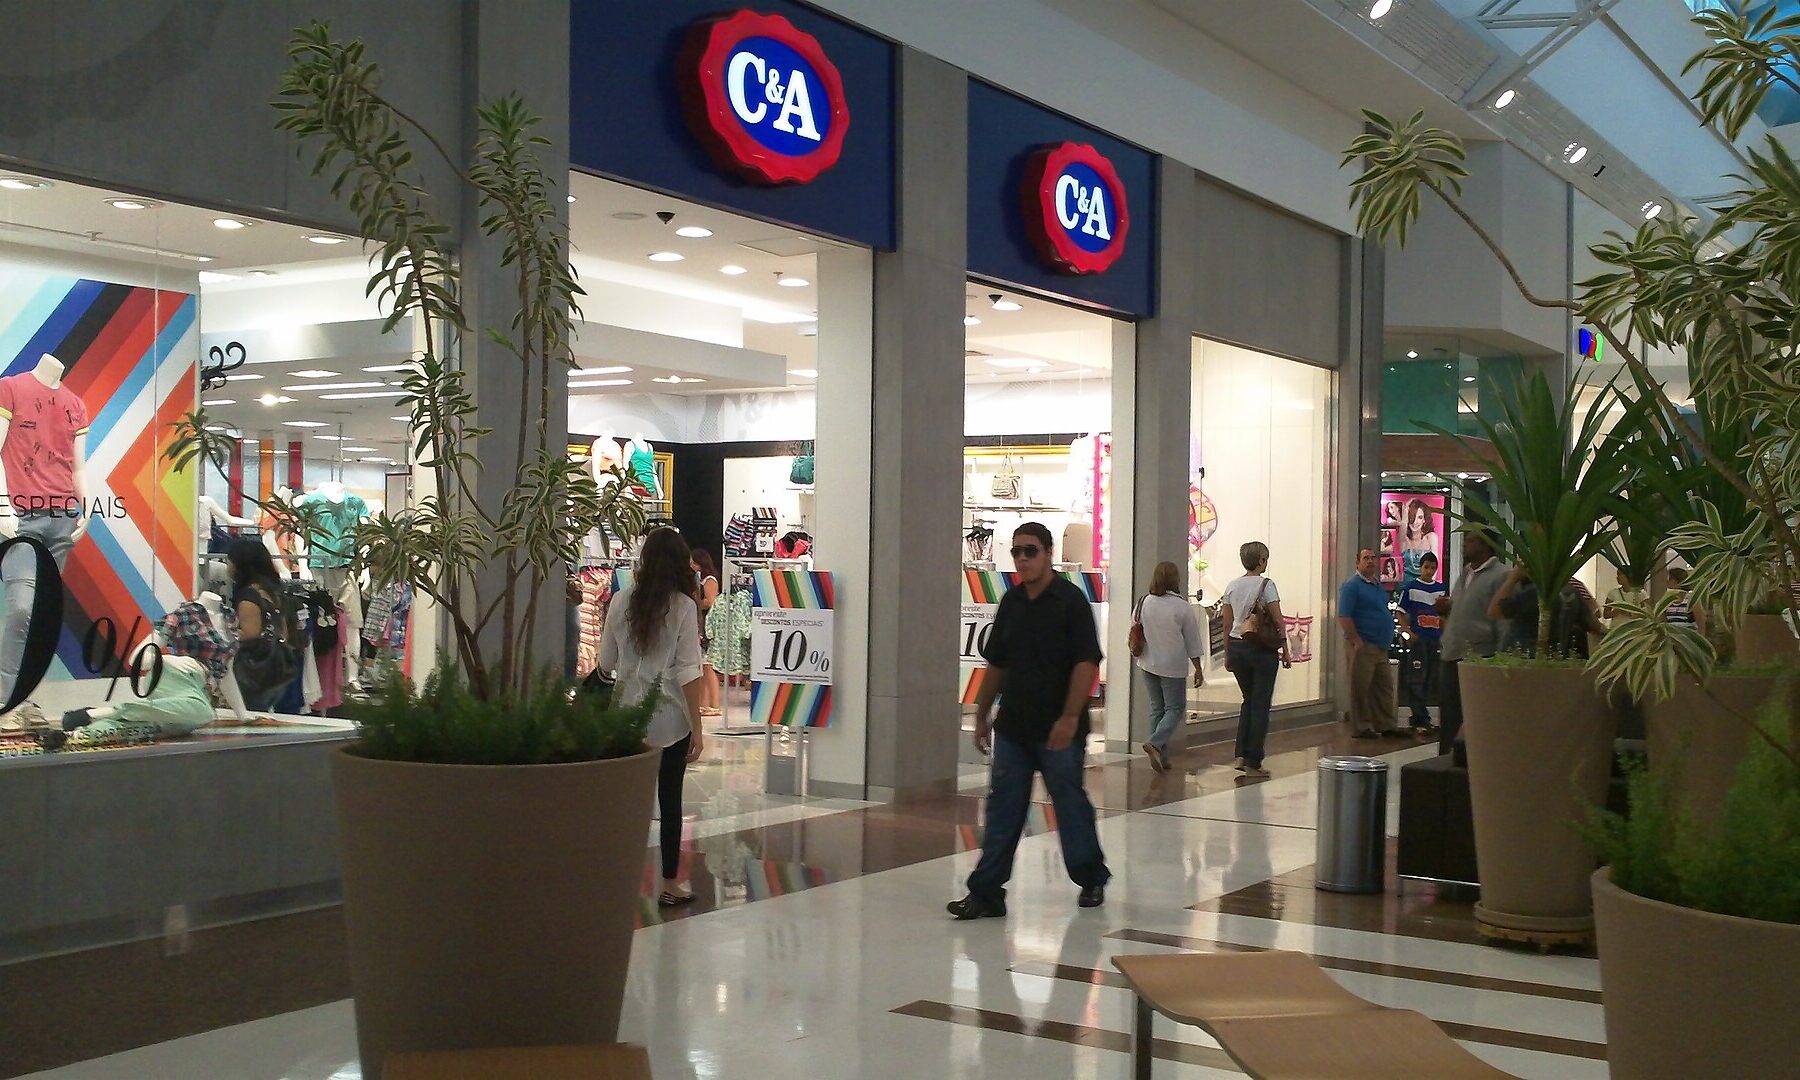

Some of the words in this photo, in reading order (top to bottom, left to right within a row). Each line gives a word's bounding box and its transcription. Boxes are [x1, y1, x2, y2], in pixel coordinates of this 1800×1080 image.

[727, 51, 821, 142] C&A
[1055, 174, 1111, 241] C&A
[0, 495, 127, 519] ESPECIAIS
[82, 615, 164, 702] %
[764, 629, 808, 672] 10
[809, 650, 830, 672] %
